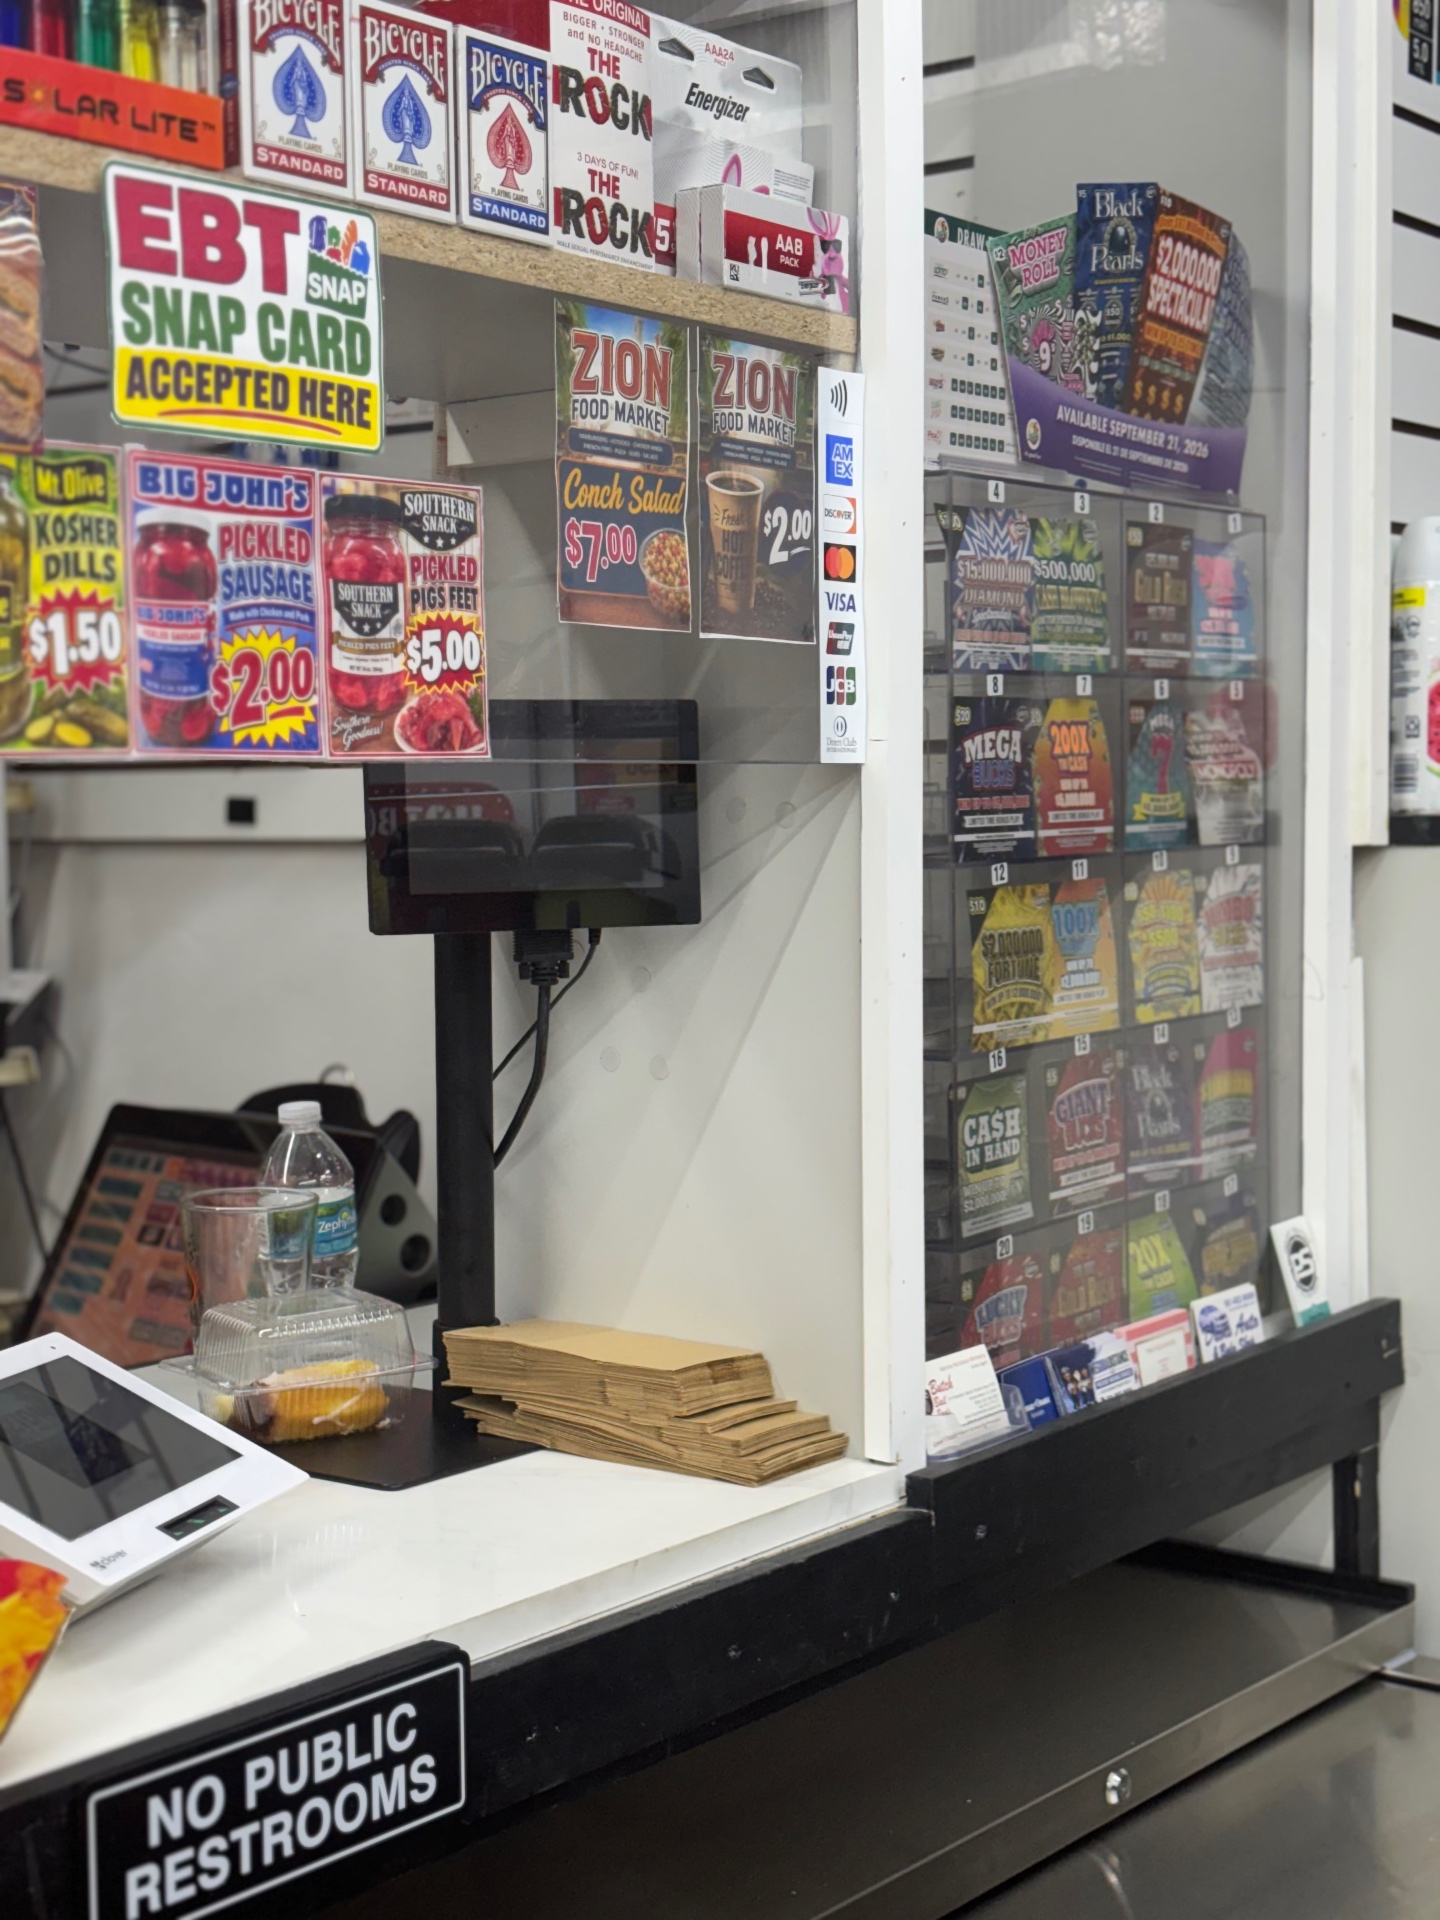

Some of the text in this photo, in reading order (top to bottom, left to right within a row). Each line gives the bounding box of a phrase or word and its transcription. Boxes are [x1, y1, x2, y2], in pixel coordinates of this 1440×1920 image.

[563, 11, 645, 51] BIGGER STRONGER
[592, 0, 647, 33] ORIGINAL
[253, 0, 341, 66] BICYCLE
[269, 29, 294, 40] TRUSTED
[567, 28, 643, 64] and NO HEADACHE
[364, 15, 445, 97] BICYCLE
[378, 59, 402, 72] TRUSTED
[587, 46, 621, 81] THE
[704, 42, 735, 62] AAA24
[714, 58, 726, 67] PACK
[470, 46, 545, 124] BICYCLE
[559, 65, 653, 142] ROCK
[684, 81, 751, 122] Energizer
[278, 135, 323, 153] PLAYING CARDS
[256, 146, 344, 181] STANDARD
[387, 162, 428, 179] PLAYING CARDS
[577, 152, 639, 180] 3 DAYS OF FUN!
[367, 173, 447, 205] STANDARD
[490, 188, 529, 204] PLAYING CARDS
[587, 168, 621, 200] THE
[472, 197, 546, 229] STANDARD
[1094, 191, 1144, 218] Black
[113, 174, 300, 297] EBT
[559, 187, 653, 259] ROCK
[957, 227, 986, 250] DRAW
[557, 240, 571, 249] MALE
[571, 243, 589, 254] SEXUAL
[775, 233, 803, 256] AA8
[1008, 227, 1067, 268] MONEY
[1090, 245, 1144, 273] Pearls
[779, 254, 799, 268] PACK
[1022, 257, 1059, 288] ROLL
[1156, 234, 1222, 296] $2,000,000
[307, 271, 366, 308] SNAP
[120, 280, 372, 378] SNAP CARD
[571, 328, 674, 411] ZION
[125, 355, 372, 430] ACCEPTED HERE
[712, 351, 799, 424] ZION
[572, 398, 670, 438] FOOD MARKET
[713, 411, 797, 448] FOOD MARKET
[1056, 404, 1210, 459] AVAILABLE SEPTEMBER 21, 2026
[832, 443, 853, 462] AM
[1071, 434, 1106, 454] DISPONIBLE
[1128, 449, 1164, 468] SEPTIEMBRE
[63, 466, 105, 500] Olive
[835, 461, 853, 478] EX
[138, 463, 308, 510] BIG JOHN'S
[564, 468, 686, 516] Conch Salad
[993, 485, 1001, 500] 4
[404, 493, 475, 524] SOUTHERN
[824, 508, 852, 521] DISCOVER
[1078, 495, 1086, 512] 3
[1153, 507, 1160, 522] 2
[36, 514, 118, 549] KOSHER
[422, 515, 458, 535] SNACK
[763, 506, 812, 565] $2.00
[218, 523, 312, 565] PICKLED
[564, 517, 637, 583] $7.00
[44, 551, 116, 584] DILLS
[409, 555, 478, 583] PICKLED
[1034, 559, 1096, 582] $500,000
[221, 564, 314, 605] SAUSAGE
[338, 583, 393, 604] SOUTHERN
[410, 586, 479, 614] PIGS FEET
[964, 588, 1025, 607] DIAMOND
[158, 608, 207, 624] JOHN'S
[259, 607, 282, 619] Chicken
[295, 611, 310, 623] Pork
[351, 602, 382, 618] SNACK
[824, 592, 856, 613] VISA
[29, 610, 122, 677] $1.50
[365, 642, 380, 650] PIGS
[380, 641, 395, 650] FEET
[407, 628, 481, 683] $5.00
[212, 648, 314, 729] $2.00
[826, 678, 855, 693] JCB
[992, 676, 998, 693] 8
[1082, 677, 1088, 693] 7
[332, 714, 370, 735] Southern
[955, 709, 971, 723] $20
[343, 721, 383, 752] Goodness!
[826, 737, 857, 747] Diners Club
[963, 729, 1022, 763] MEGA
[1050, 724, 1090, 755] 200X
[993, 864, 1005, 882] 12
[1074, 861, 1085, 877] 11
[969, 900, 985, 913] $10
[1054, 906, 1098, 938] 100X
[982, 927, 1045, 957] $2,000,000
[987, 956, 1042, 991] FORTUNE
[1077, 1036, 1087, 1053] 15
[1157, 1026, 1166, 1042] 14
[992, 1051, 1004, 1070] 16
[1132, 1065, 1173, 1091] Black
[1055, 1079, 1109, 1125] GIANT
[964, 1107, 1021, 1147] CA$H
[966, 1138, 1020, 1168] IN HAND
[1080, 1214, 1091, 1232] 19
[999, 1238, 1010, 1258] 20
[1129, 1234, 1172, 1273] 20X
[100, 1549, 128, 1566] clover
[147, 1702, 418, 1850] NO PUBLIC
[125, 1753, 437, 1920] RESTROOMS
